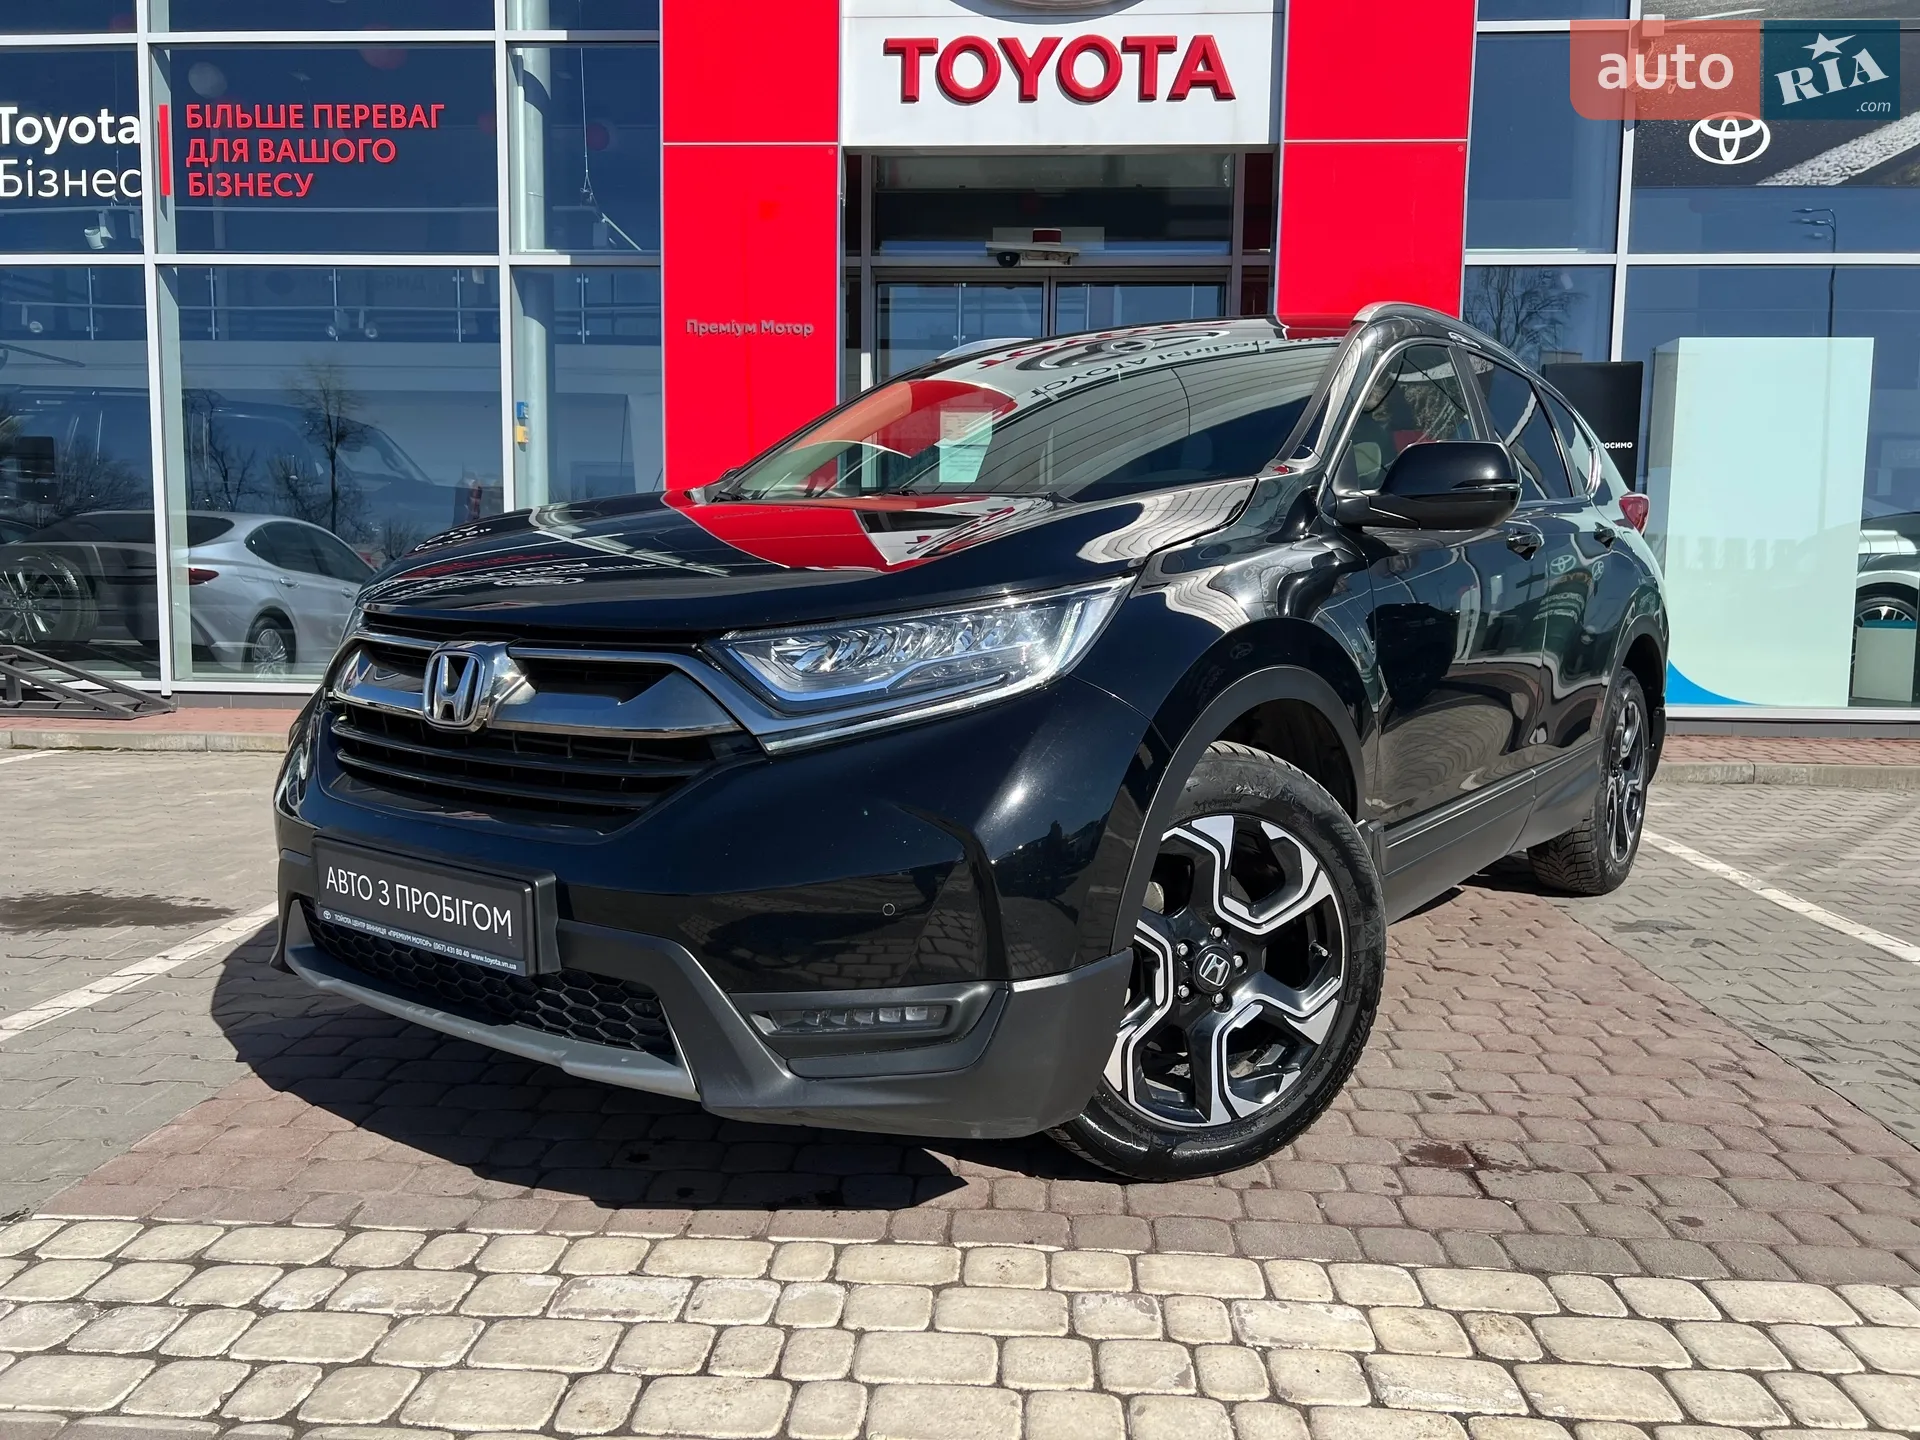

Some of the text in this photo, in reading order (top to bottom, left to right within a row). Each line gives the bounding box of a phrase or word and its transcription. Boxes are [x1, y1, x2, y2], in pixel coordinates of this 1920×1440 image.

[884, 34, 1236, 105] TOYOTA
[0, 106, 140, 155] Toyota
[185, 104, 445, 129] БІЛЬШЕ ПЕРЕВАГ
[185, 138, 396, 168] ДЛЯ ВАШОГО
[0, 159, 142, 198] Бізнес
[187, 172, 314, 197] БІЗНЕСУ
[686, 319, 814, 338] Преміум Мотор
[326, 866, 373, 901] АВТО
[395, 883, 512, 937] ПРОБІГОМ
